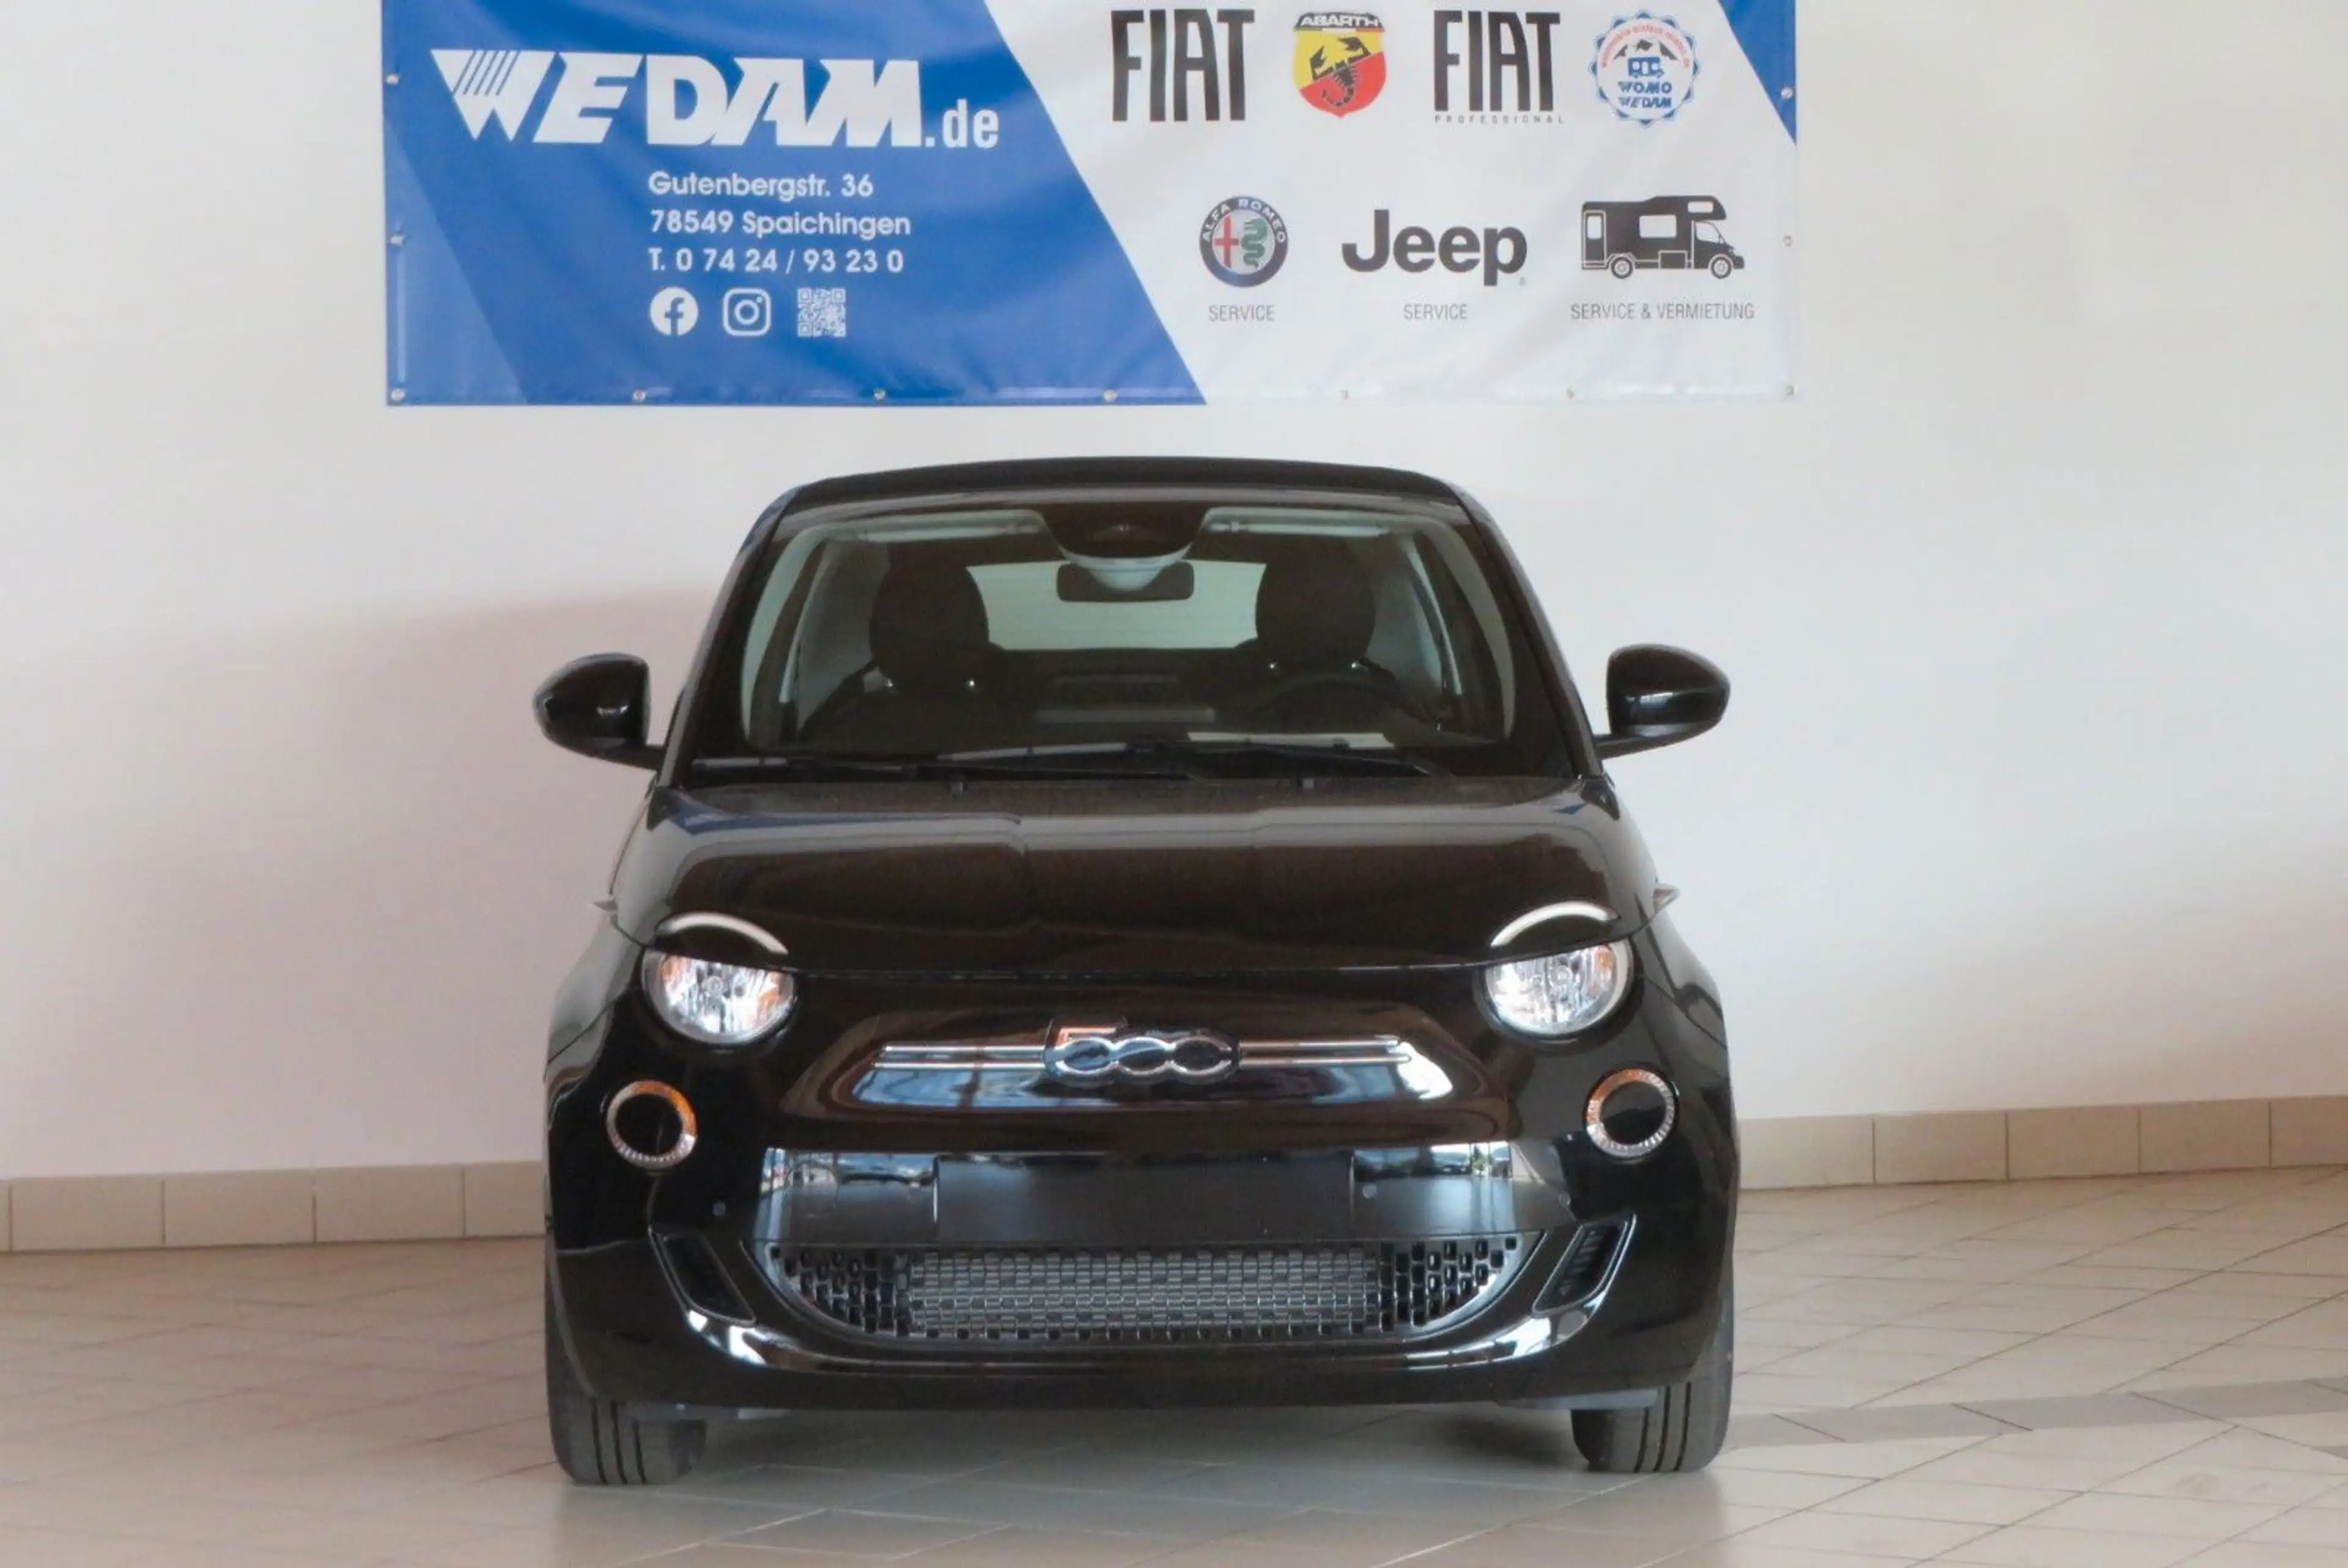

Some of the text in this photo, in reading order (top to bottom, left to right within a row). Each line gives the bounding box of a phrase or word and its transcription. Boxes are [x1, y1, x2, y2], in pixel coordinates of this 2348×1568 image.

[1300, 15, 1379, 28] ABARTH
[1112, 9, 1255, 122] FIAT
[1434, 10, 1560, 112] FIAT
[430, 48, 999, 148] WEDAM.de
[1618, 81, 1672, 94] WOMO
[1618, 97, 1672, 108] WEDAM
[1434, 115, 1563, 124] PROFESSIONAL
[648, 171, 874, 202] Gutenbergstr. 36
[651, 209, 911, 241] 78549 Spaichingen
[1202, 198, 1287, 243] ALFA ROMEO
[1342, 209, 1527, 286] Jeep
[648, 248, 904, 275] T. 0 74 24 / 93 23 0
[1209, 305, 1274, 322] SERVICE
[1403, 303, 1468, 320] SERVICE
[1571, 303, 1755, 320] SERVICE & VERMIETUNG
